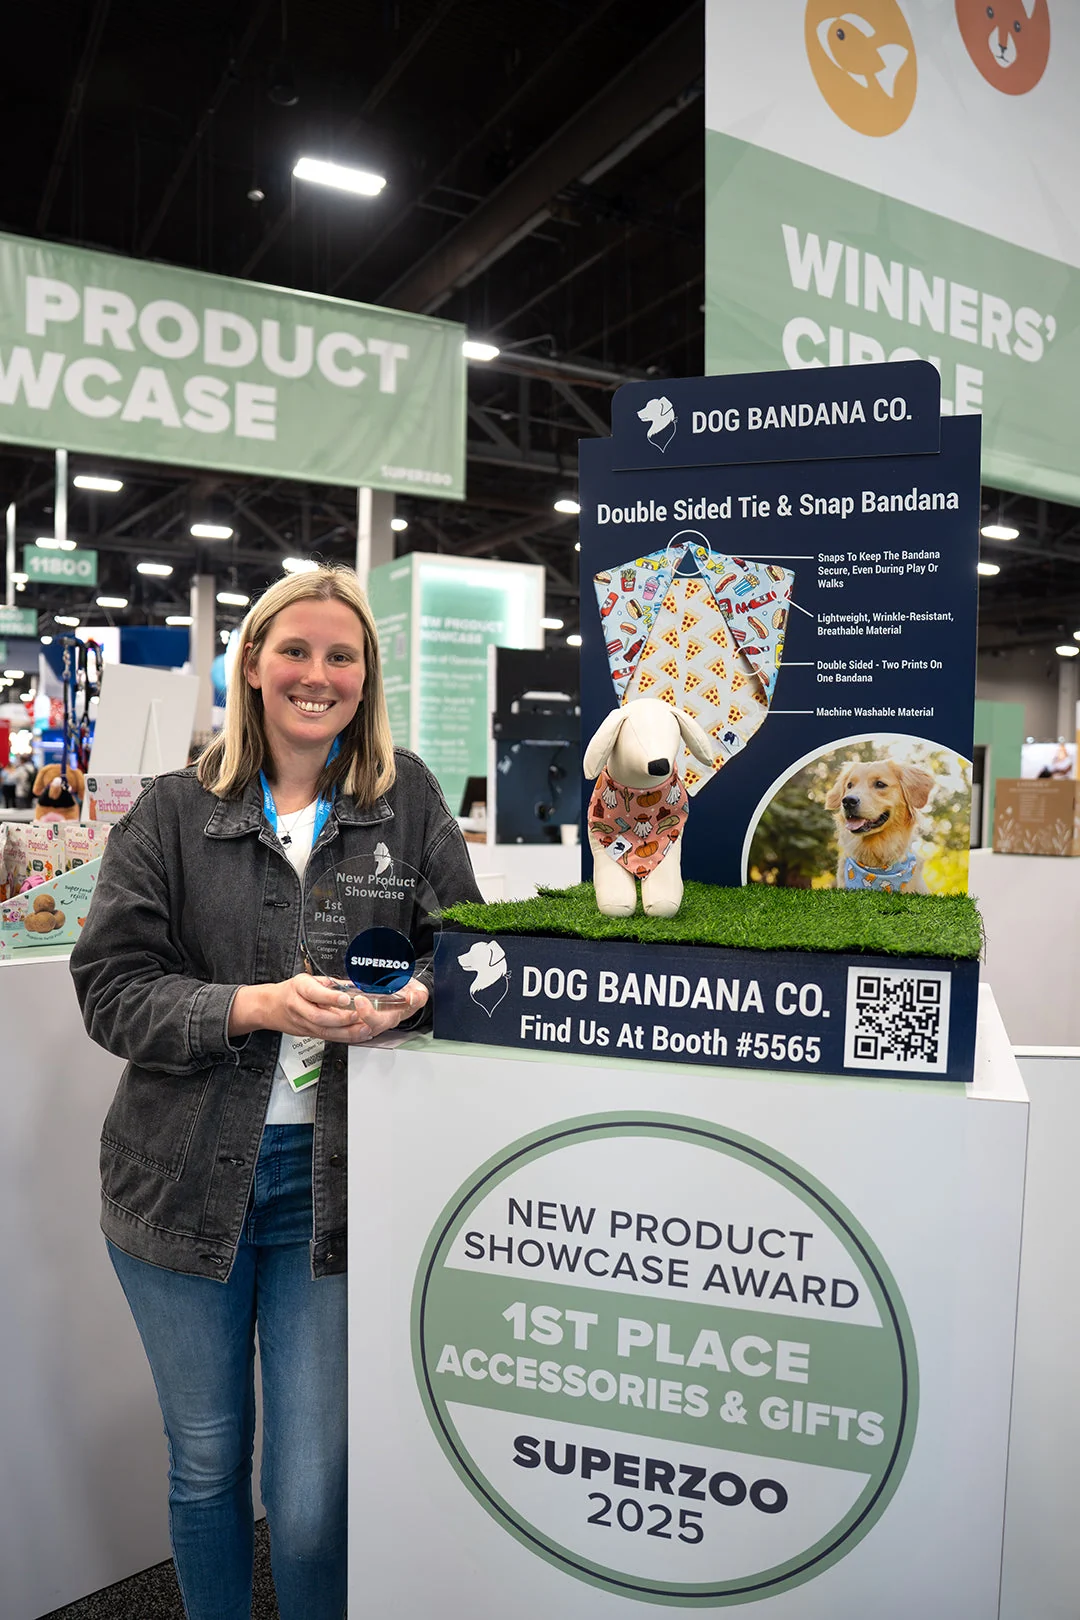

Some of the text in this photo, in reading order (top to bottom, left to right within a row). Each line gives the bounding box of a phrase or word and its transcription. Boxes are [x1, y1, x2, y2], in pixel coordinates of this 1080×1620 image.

[25, 274, 409, 395] PRODUCT
[692, 397, 912, 434] DOG BANDANA CO.
[597, 487, 960, 524] Double Sided Tie & Snap Bandana
[818, 549, 940, 564] Snaps To Keep The Bandana
[30, 556, 92, 577] 11800
[818, 563, 939, 576] Secure, Even During Play Or
[818, 579, 844, 588] Walks
[817, 611, 954, 625] Lightweight, Wrinkle-Resistant,
[817, 625, 902, 636] Breathable Material
[817, 660, 847, 669] Double
[849, 659, 873, 669] Sided
[882, 660, 899, 669] Two
[902, 659, 928, 669] Prints
[930, 659, 943, 669] On
[816, 673, 873, 683] One Bandana
[816, 707, 934, 717] Machine Washable Material
[336, 872, 415, 888] New Product
[345, 886, 405, 900] Showcase
[324, 899, 342, 910] 1st
[314, 912, 346, 923] Place
[316, 945, 338, 953] Category
[350, 956, 410, 970] SUPERZOO
[522, 966, 831, 1018] DOG BANDANA CO.
[520, 1014, 822, 1064] Find Us At Booth #5565
[508, 1198, 813, 1262] NEW PRODUCT
[464, 1231, 859, 1310] SHOWCASE AWARD
[502, 1301, 811, 1384] 1ST PLACE
[436, 1344, 885, 1446] ACCESSORIES & GIFTS
[512, 1435, 788, 1515] SUPERZOO
[587, 1492, 704, 1545] 2025
